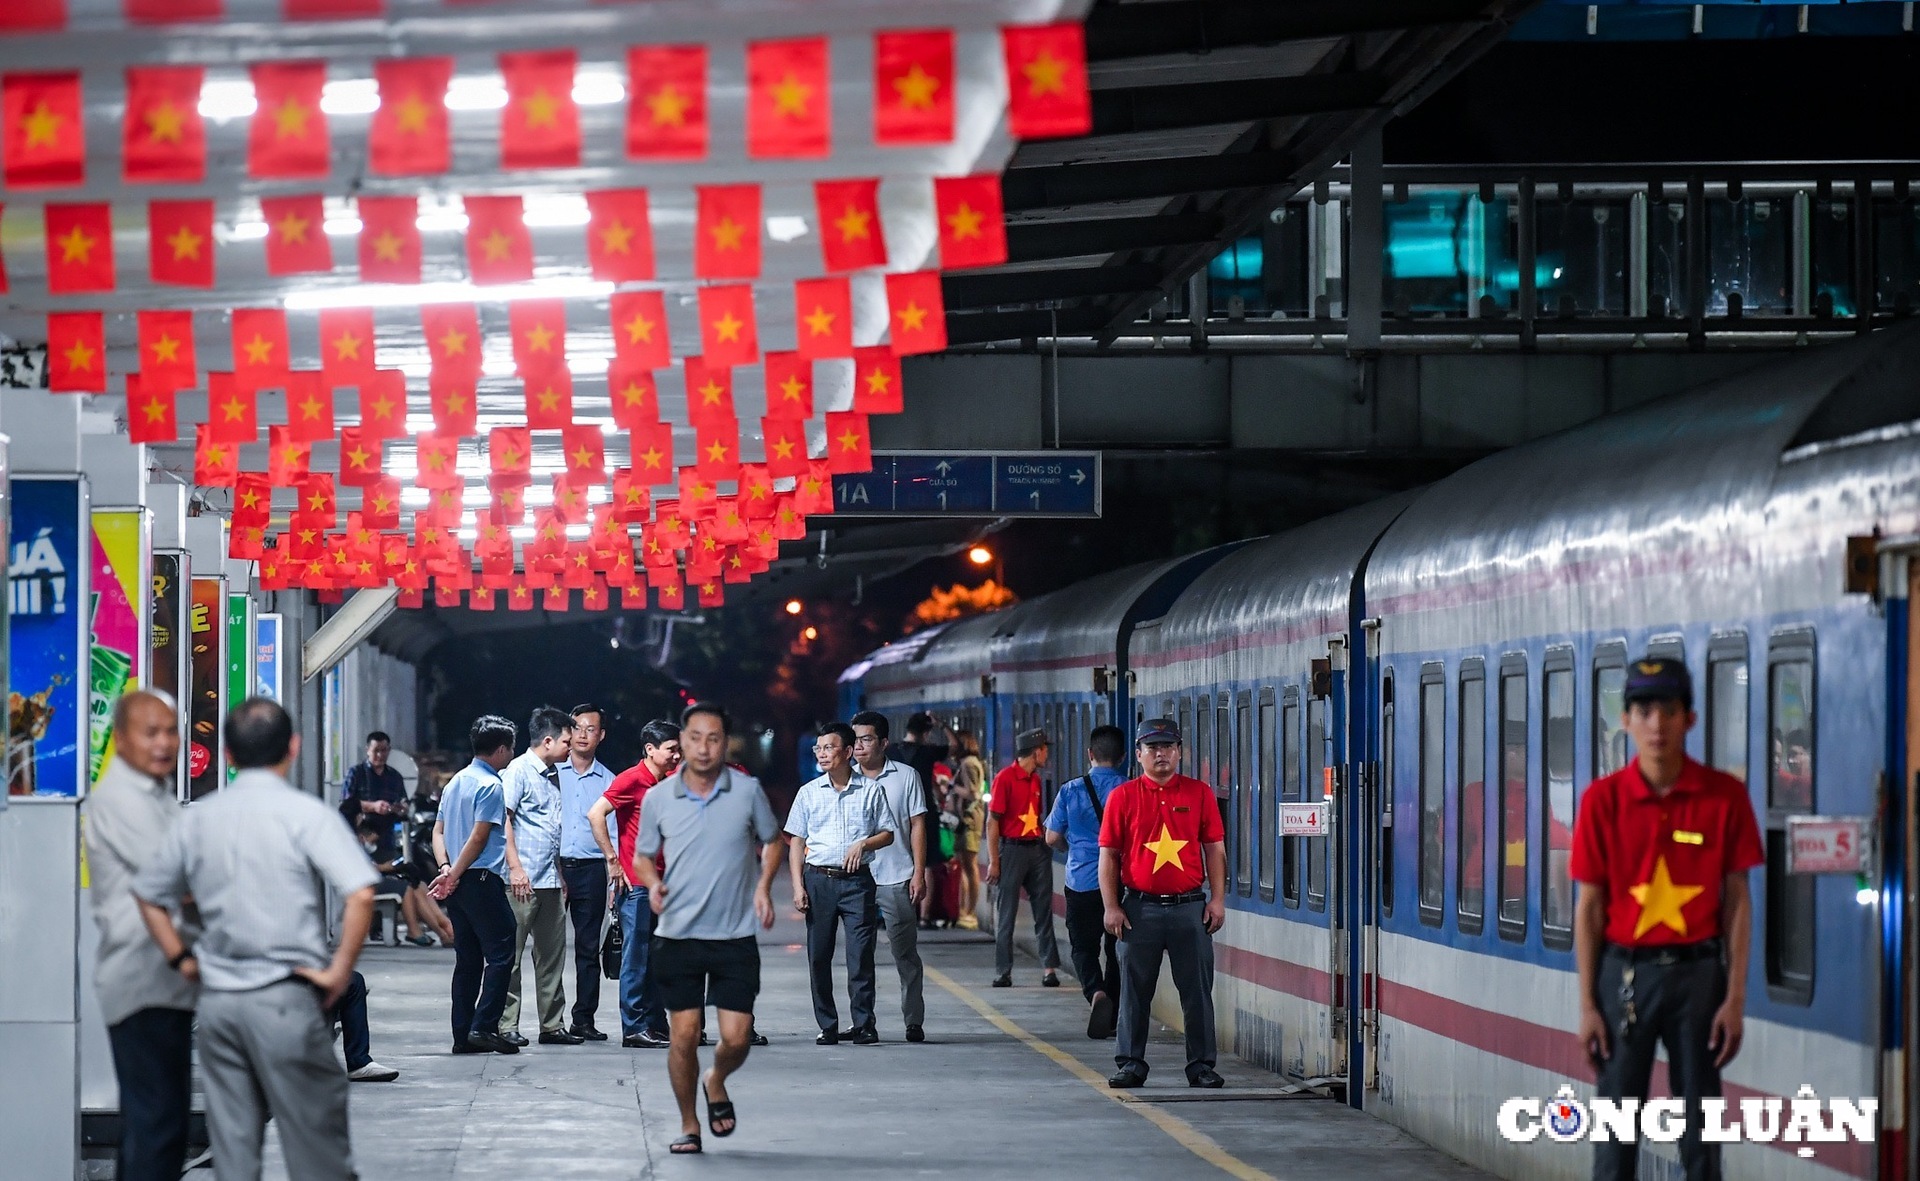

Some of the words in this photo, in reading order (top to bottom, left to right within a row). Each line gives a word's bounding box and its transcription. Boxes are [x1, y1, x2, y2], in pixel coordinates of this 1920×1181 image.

[837, 482, 870, 505] 1A
[937, 489, 947, 511] 1
[1030, 489, 1040, 511] 1
[1284, 815, 1303, 825] TOA
[1306, 811, 1317, 826] 4
[1835, 831, 1851, 859] 5
